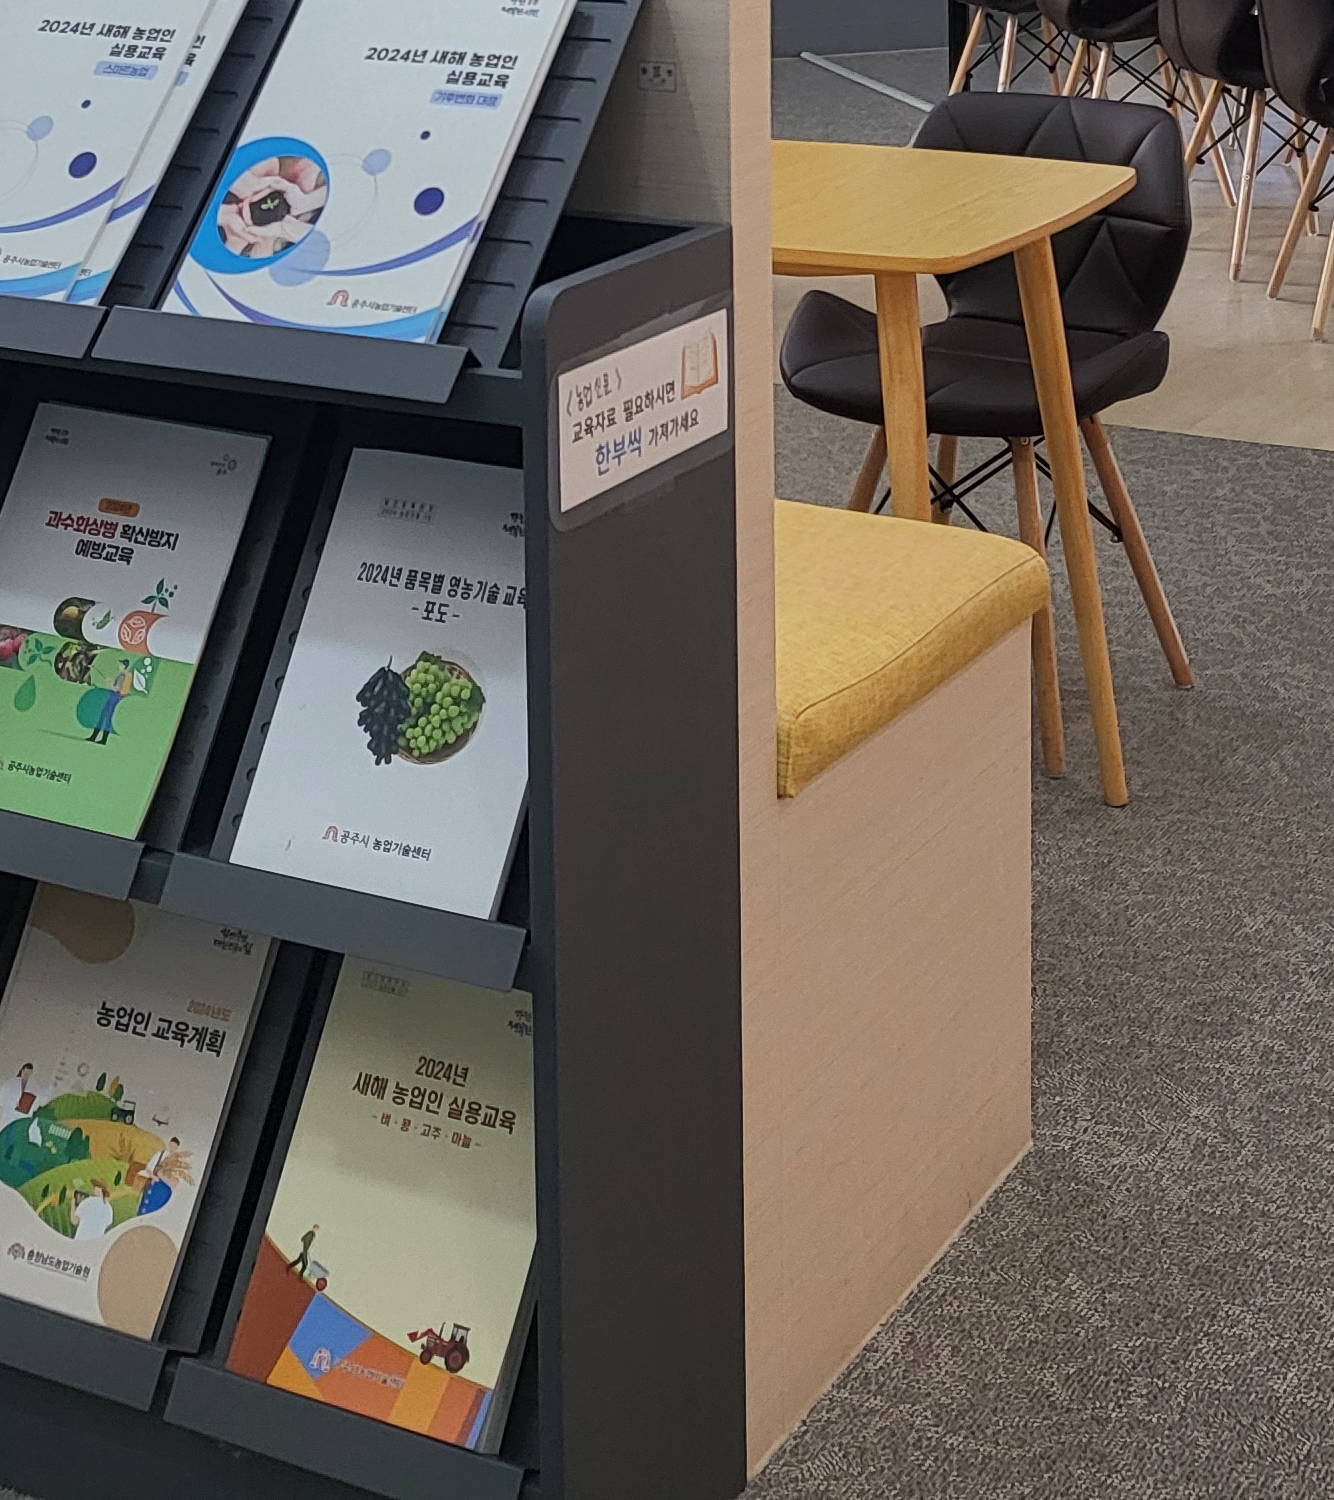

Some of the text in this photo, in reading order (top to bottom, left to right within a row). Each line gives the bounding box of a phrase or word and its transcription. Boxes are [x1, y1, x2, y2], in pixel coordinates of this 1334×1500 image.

[38, 19, 176, 43] 2024년 새해 농업인
[109, 43, 167, 60] 실용교육
[364, 47, 518, 70] 2024년 새해 농업인
[446, 69, 510, 89] 실용교육
[572, 380, 676, 444] 교육자료 필요하시면
[595, 408, 700, 477] 한부씩 가져가세요
[45, 510, 180, 551] 과수화상병 확산방지
[74, 538, 135, 566] 예방교육
[356, 561, 403, 588] 2024년
[404, 568, 446, 595] 품목별
[446, 575, 501, 605] 영농기술
[8, 760, 72, 784] 공주시농업기술센터
[340, 830, 432, 862] 공주시 농업기술센터
[97, 1001, 227, 1058] 농업인 교육계획
[415, 1056, 469, 1087] 2024년
[352, 1071, 517, 1134] 새해 농업인 실용교육
